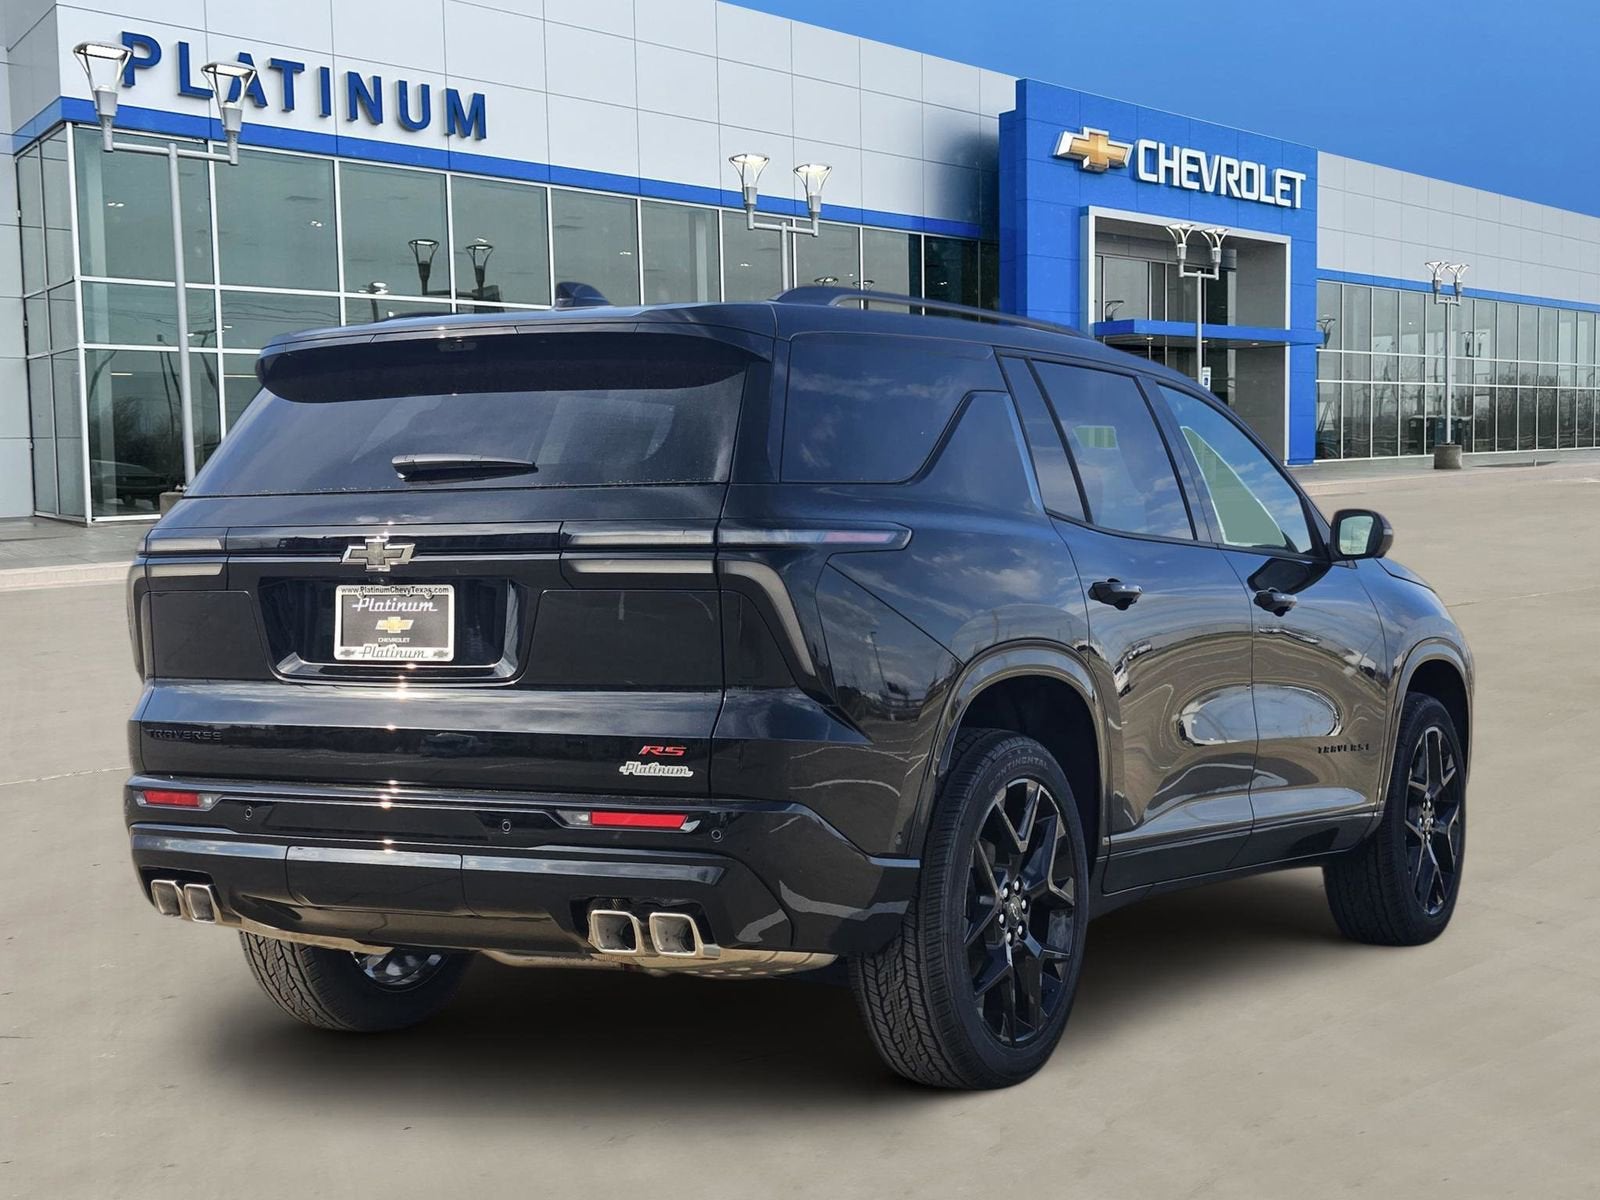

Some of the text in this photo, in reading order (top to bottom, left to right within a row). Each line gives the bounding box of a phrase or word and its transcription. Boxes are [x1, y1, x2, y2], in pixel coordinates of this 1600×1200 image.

[121, 31, 487, 140] PLATINUM
[1136, 138, 1306, 209] CHEVROLET
[341, 586, 449, 596] www.PlatinumChevyTexas.com
[352, 598, 438, 612] Platinum
[358, 644, 430, 659] Platinum
[145, 728, 223, 741] TRAVERSE
[638, 745, 687, 756] RS
[619, 761, 694, 777] Platinum
